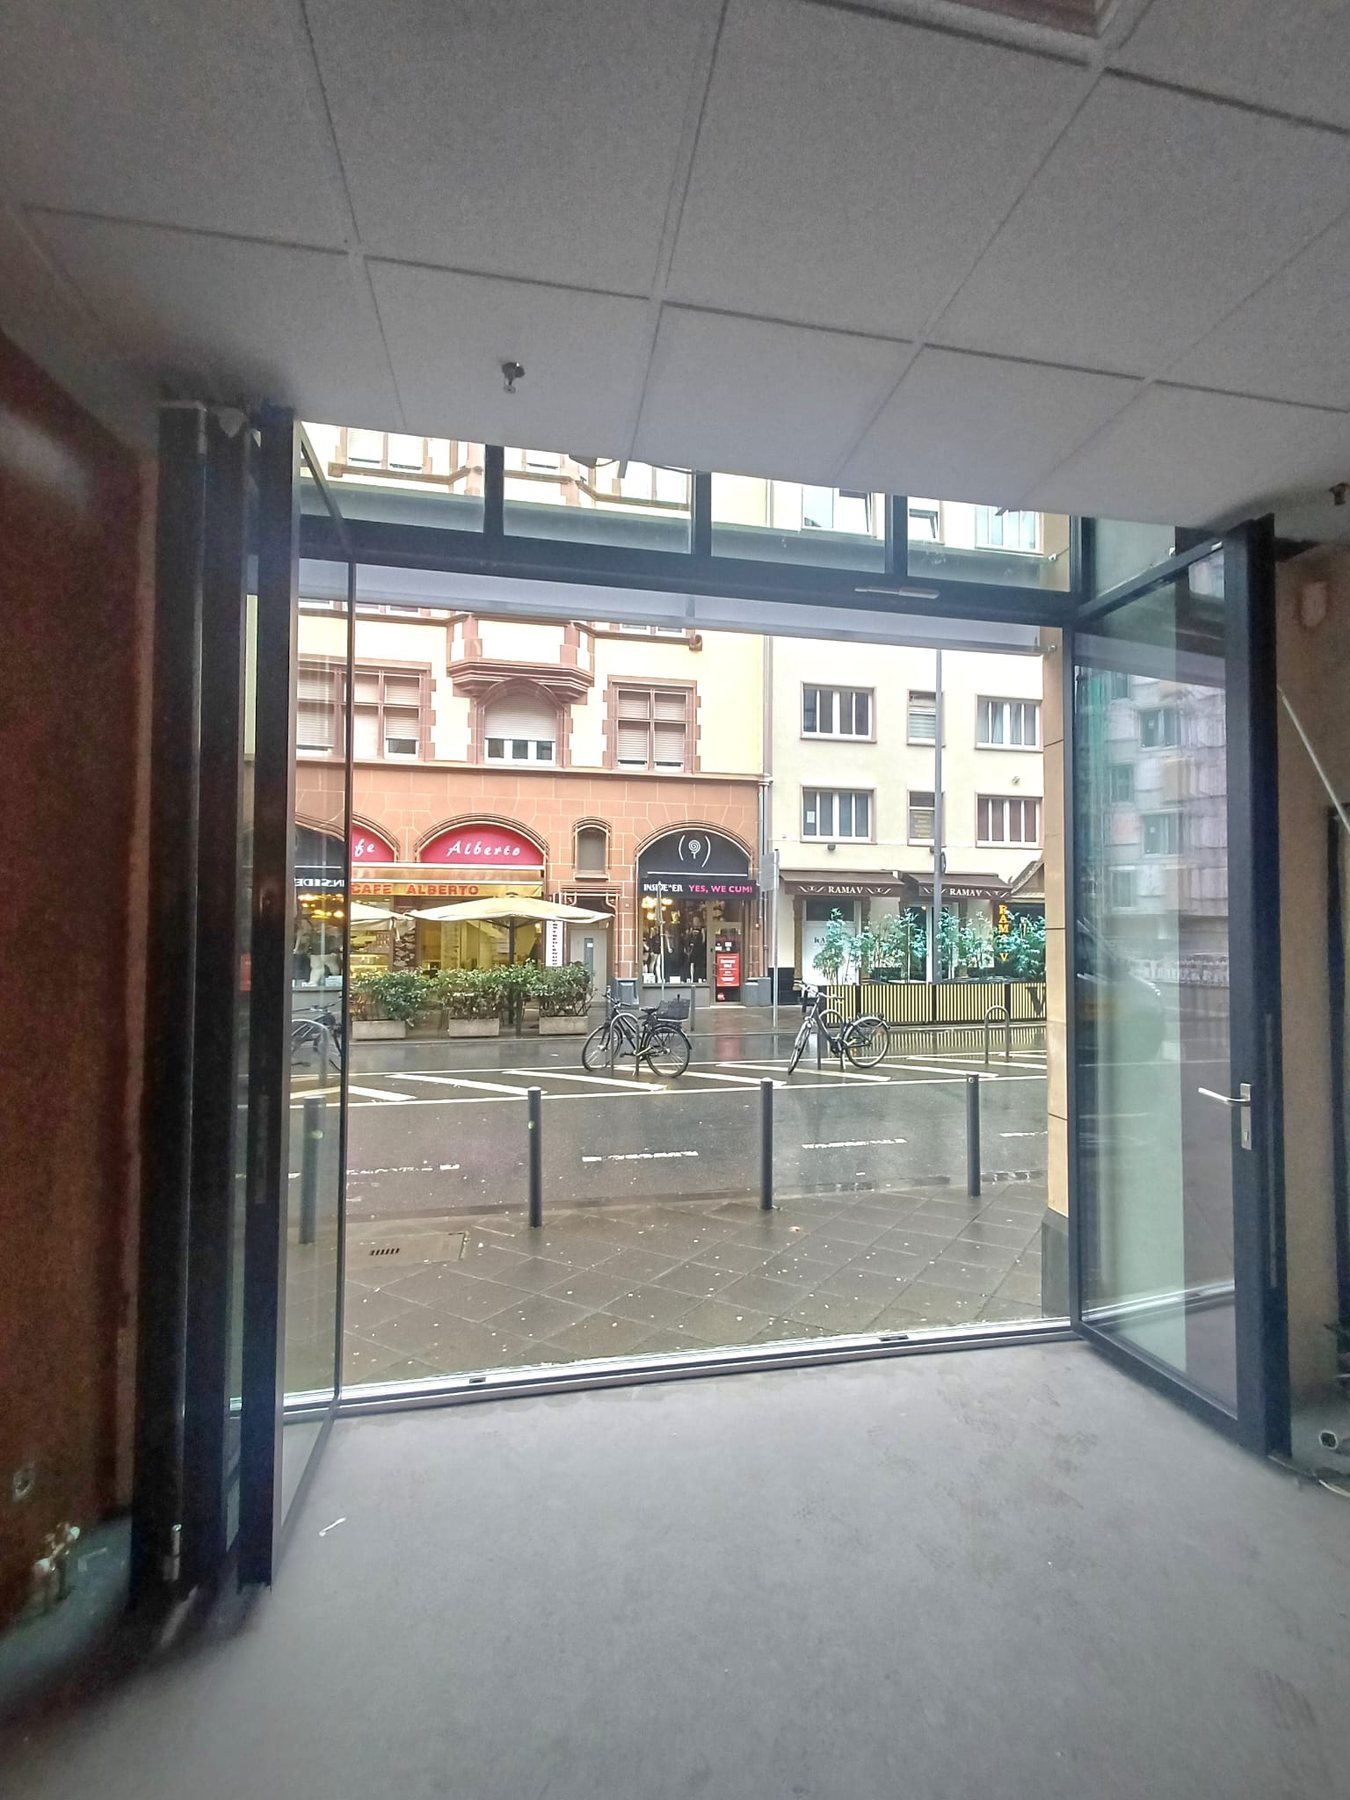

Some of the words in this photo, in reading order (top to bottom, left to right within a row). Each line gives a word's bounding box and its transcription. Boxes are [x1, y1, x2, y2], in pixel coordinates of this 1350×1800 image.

[446, 841, 520, 857] Alberto
[351, 884, 392, 895] CAFE
[406, 884, 480, 896] ALBERTO
[688, 884, 709, 894] YES,
[711, 885, 726, 893] WE
[728, 885, 753, 894] CUM!
[828, 885, 864, 894] RAMAV
[949, 888, 982, 897] RAMAV
[998, 904, 1009, 962] RAMV
